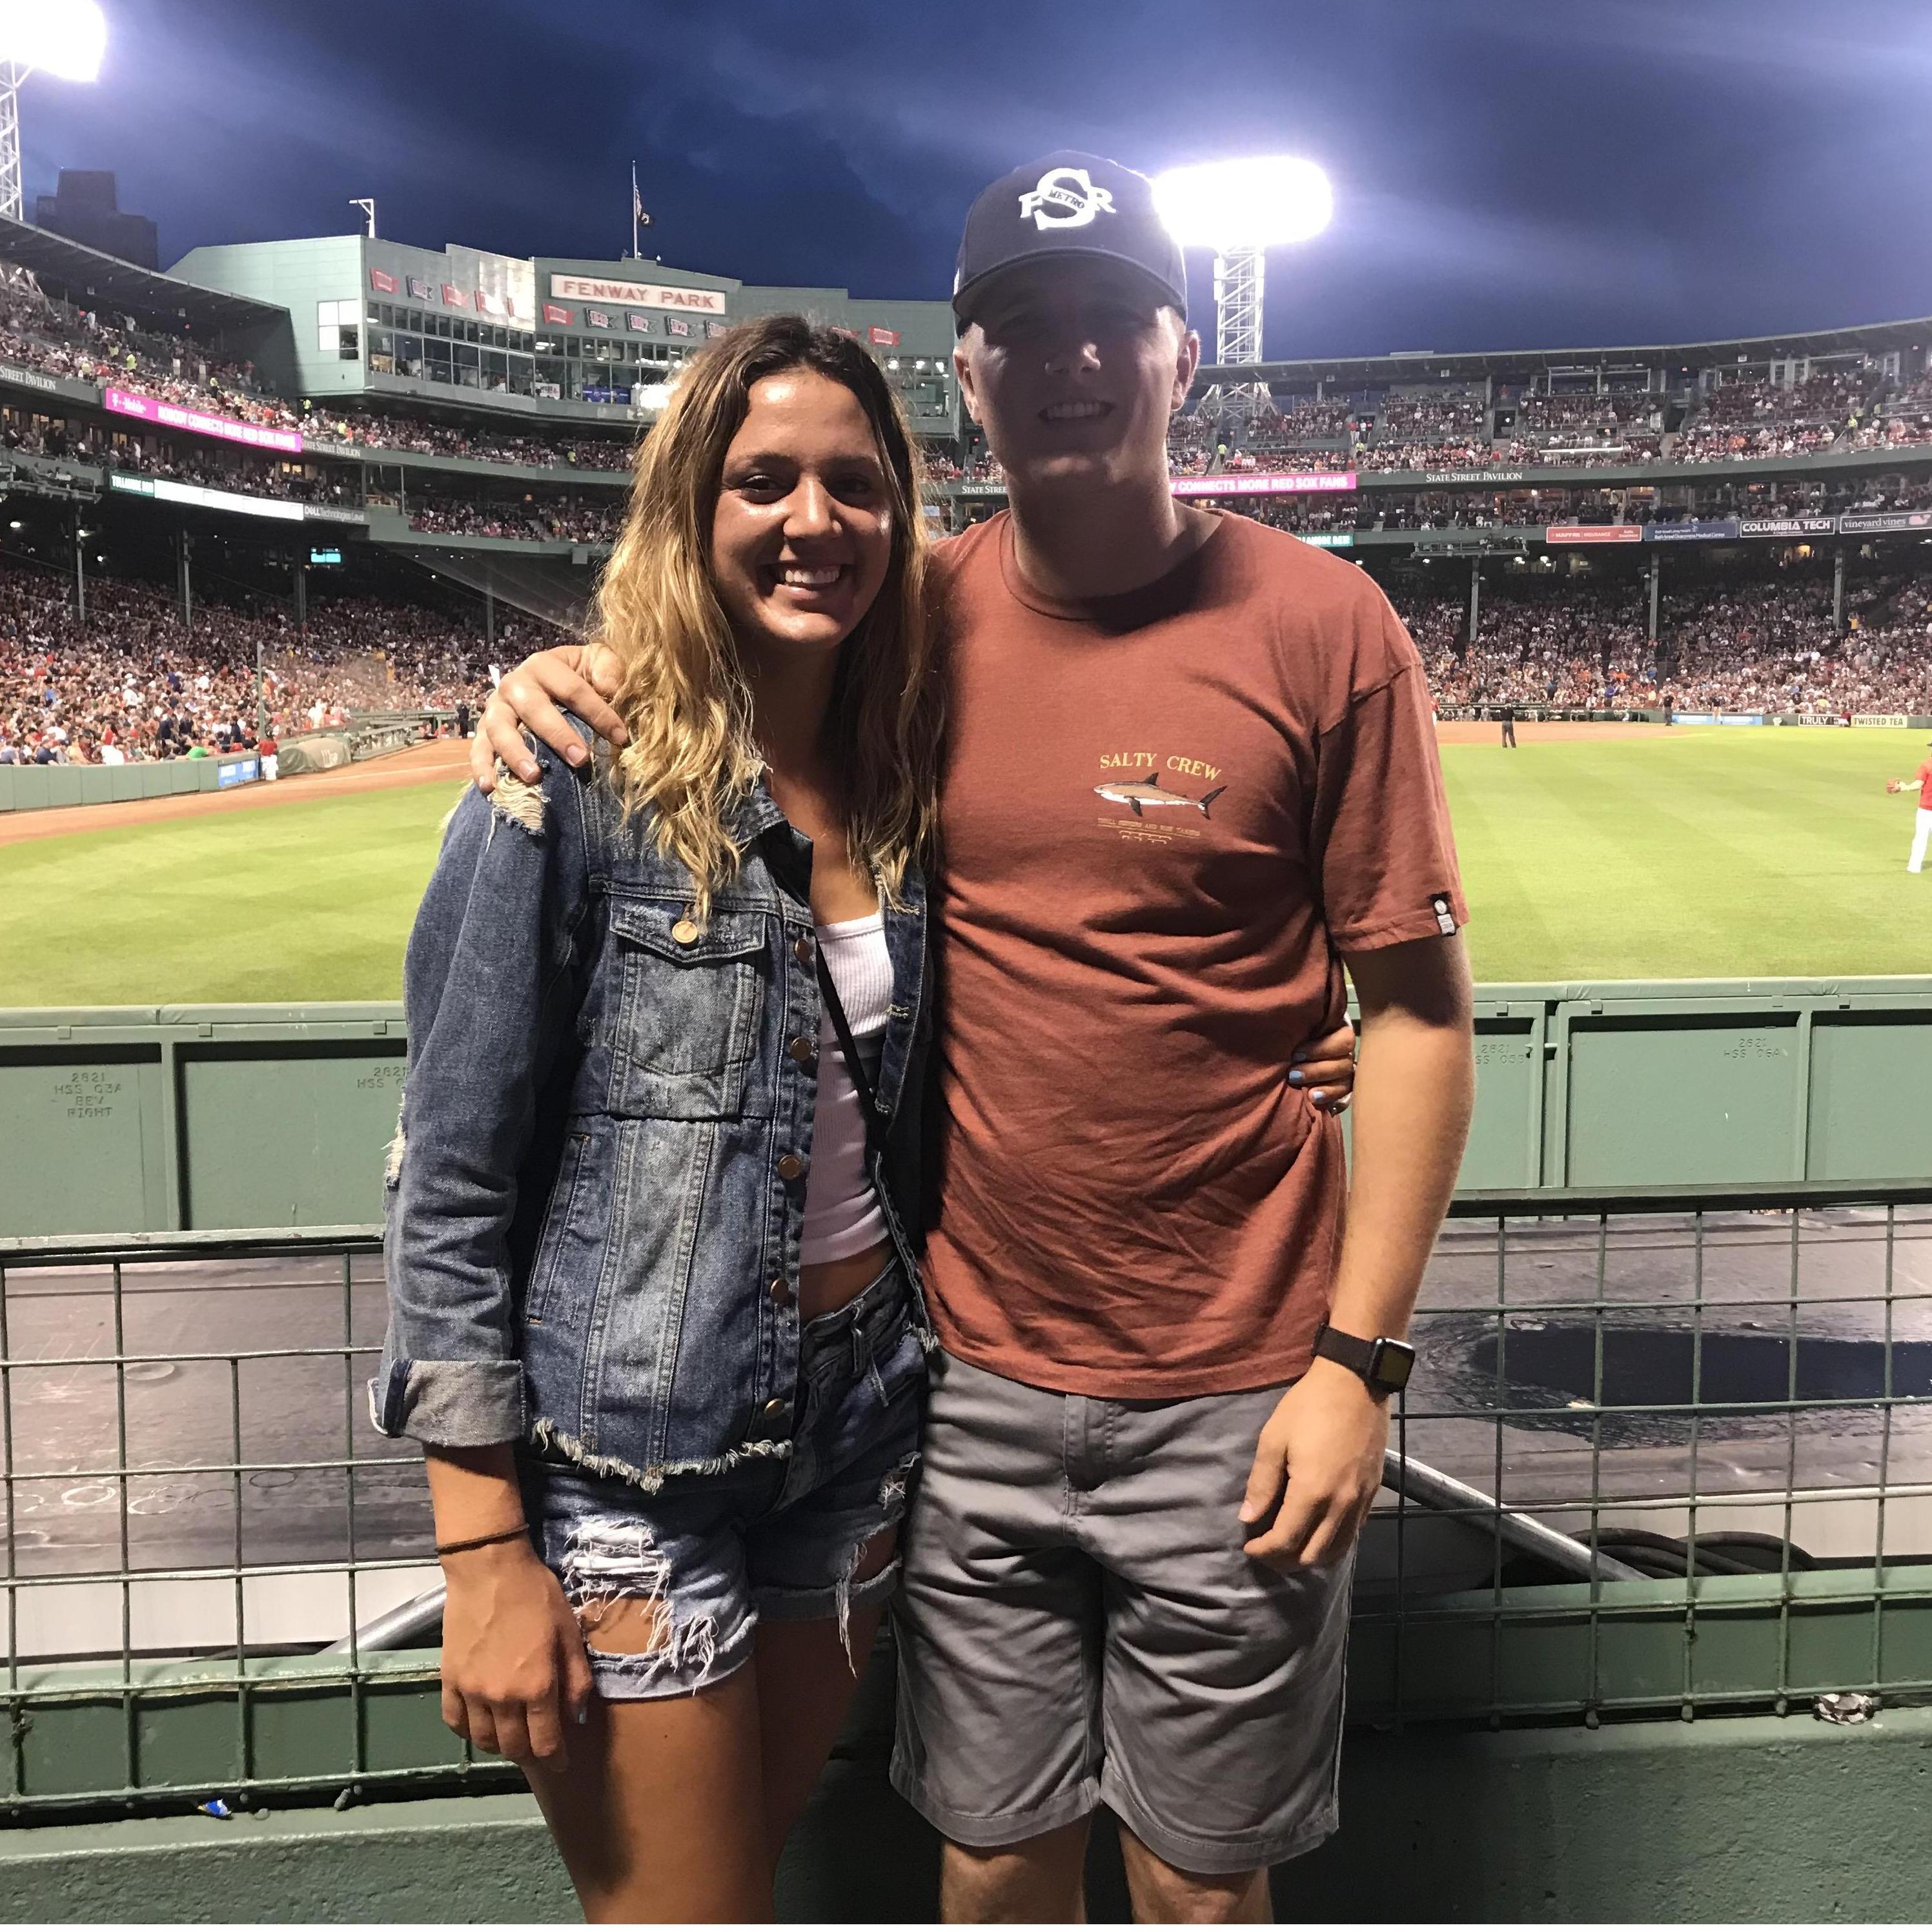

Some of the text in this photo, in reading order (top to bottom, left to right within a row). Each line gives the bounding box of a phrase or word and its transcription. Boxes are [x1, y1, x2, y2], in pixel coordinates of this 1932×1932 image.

[1048, 189, 1085, 209] METRO
[564, 281, 715, 309] FENWAY PARK
[25, 371, 56, 390] PAVILION
[317, 441, 336, 454] STREET
[336, 444, 361, 458] PAVILION
[1426, 472, 1523, 482] STATE STREET PAVILION
[962, 485, 1008, 494] STATE STREE
[1178, 480, 1236, 493] CONNECTS
[1237, 478, 1269, 491] MORE
[1271, 478, 1294, 490] RED
[1296, 477, 1318, 489] SOX
[1320, 476, 1348, 488] FANS
[305, 505, 321, 516] DELL
[1742, 520, 1831, 532] COLUMBIA TECH
[1844, 517, 1906, 529] vineyard vines
[1802, 716, 1829, 725] TRULY
[1853, 717, 1887, 726] TWISTED
[1099, 752, 1222, 781] SALTY CREW
[1475, 1055, 1490, 1064] SS
[72, 1072, 105, 1083] 2821
[357, 1078, 384, 1088] HSS
[55, 1084, 82, 1095] HSS
[67, 1106, 113, 1118] RIGHT
